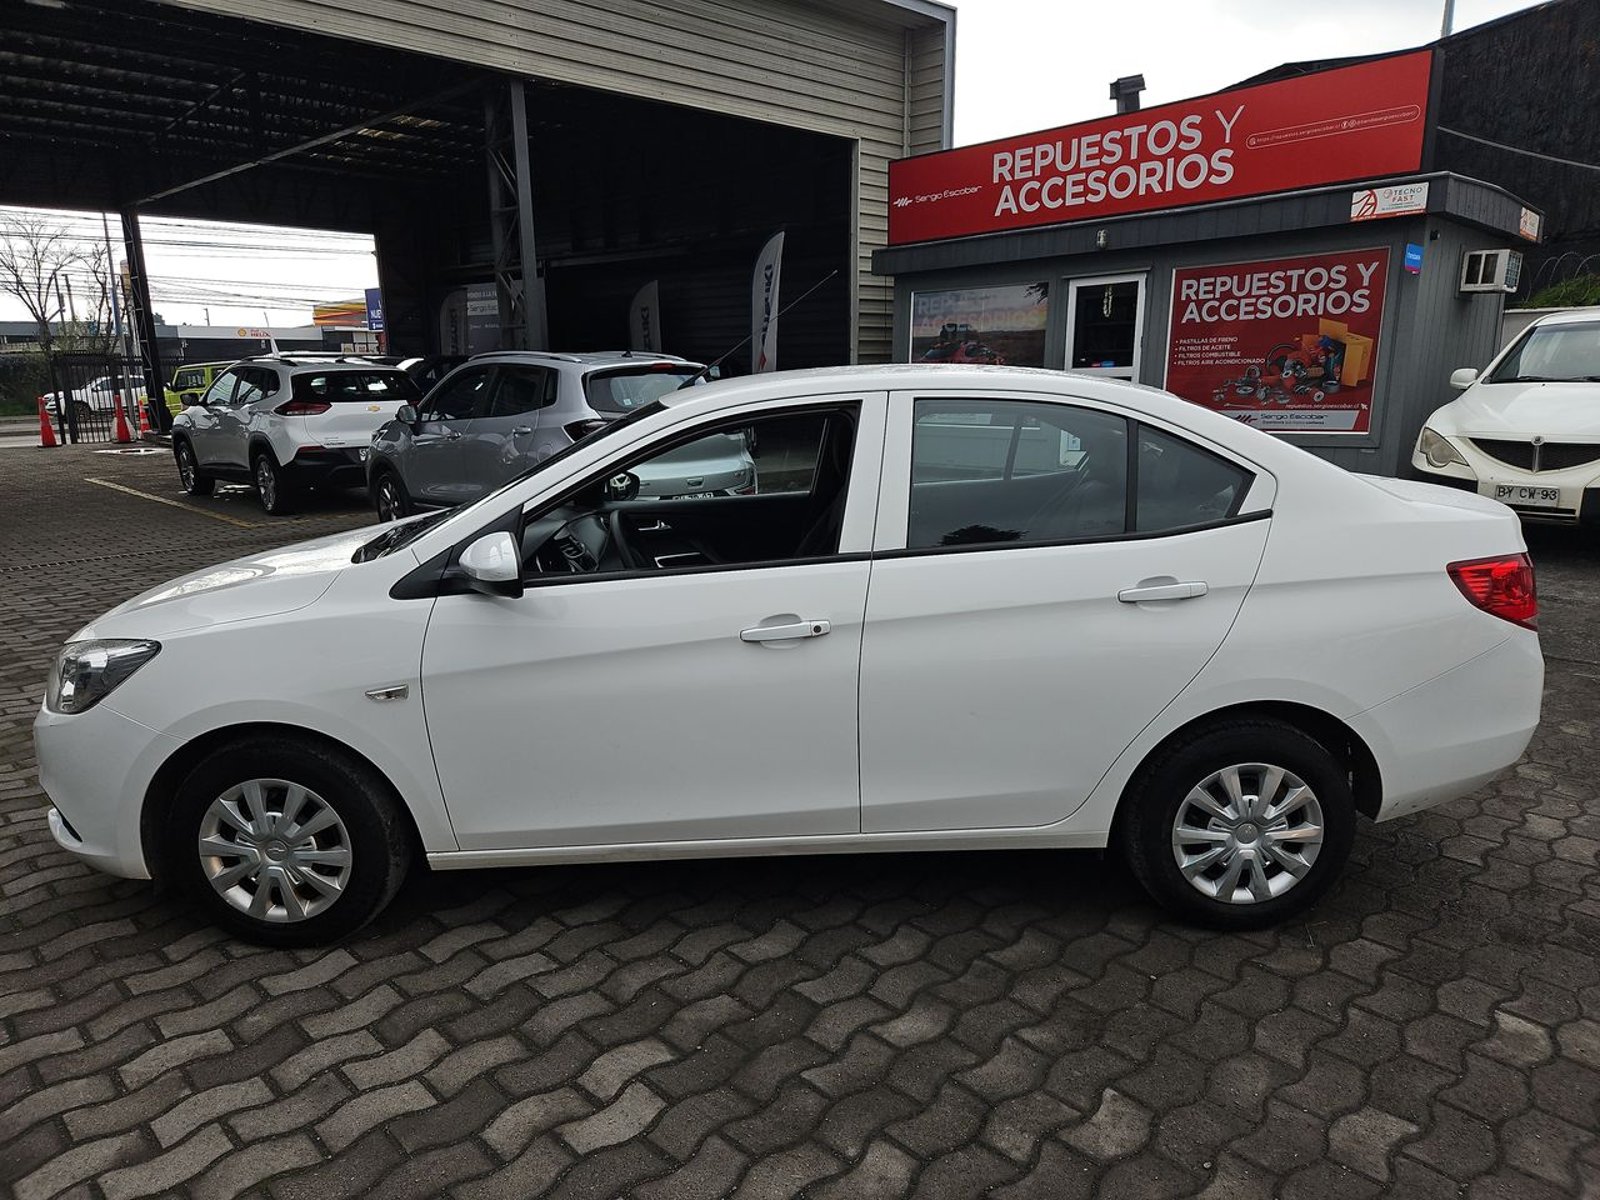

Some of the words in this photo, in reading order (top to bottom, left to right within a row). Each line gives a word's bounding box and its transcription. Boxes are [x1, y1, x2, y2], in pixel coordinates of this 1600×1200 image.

[993, 115, 1202, 184] REPUESTOS
[1215, 104, 1245, 144] Y
[943, 184, 983, 199] Escobar
[994, 148, 1235, 217] ACCESORIOS
[1392, 195, 1415, 203] FAST
[1394, 186, 1423, 196] TECNO
[1180, 264, 1348, 301] REPUESTOS
[1357, 260, 1380, 287] Y
[1180, 288, 1371, 325] ACCESORIOS
